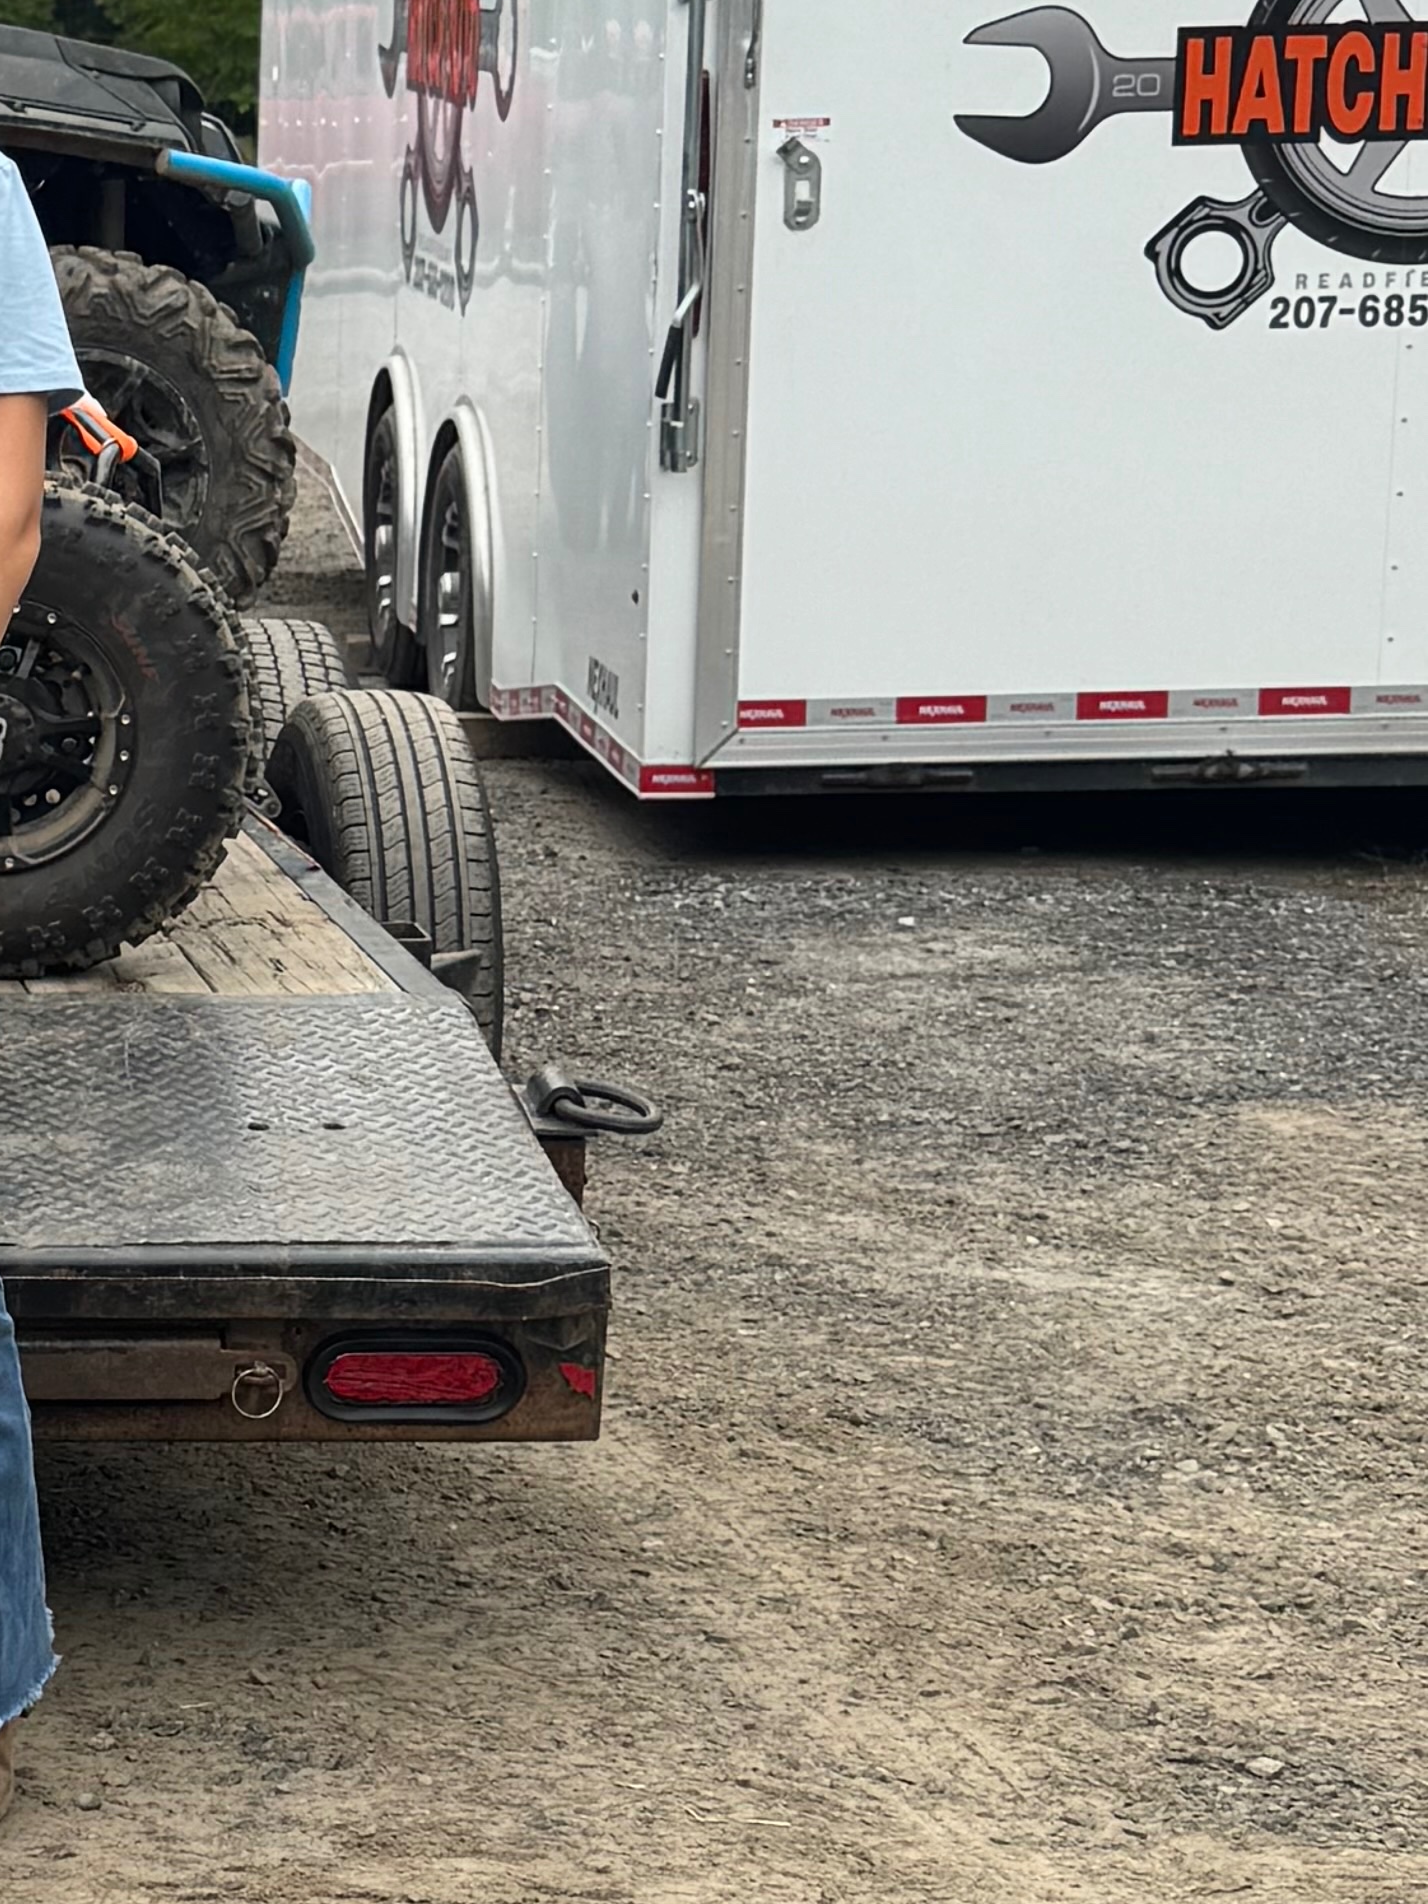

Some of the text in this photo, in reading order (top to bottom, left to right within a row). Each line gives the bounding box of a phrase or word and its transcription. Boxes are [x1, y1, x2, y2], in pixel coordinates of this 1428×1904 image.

[1112, 73, 1160, 97] 20
[1182, 30, 1428, 136] HATCH
[1269, 294, 1428, 329] 207-685
